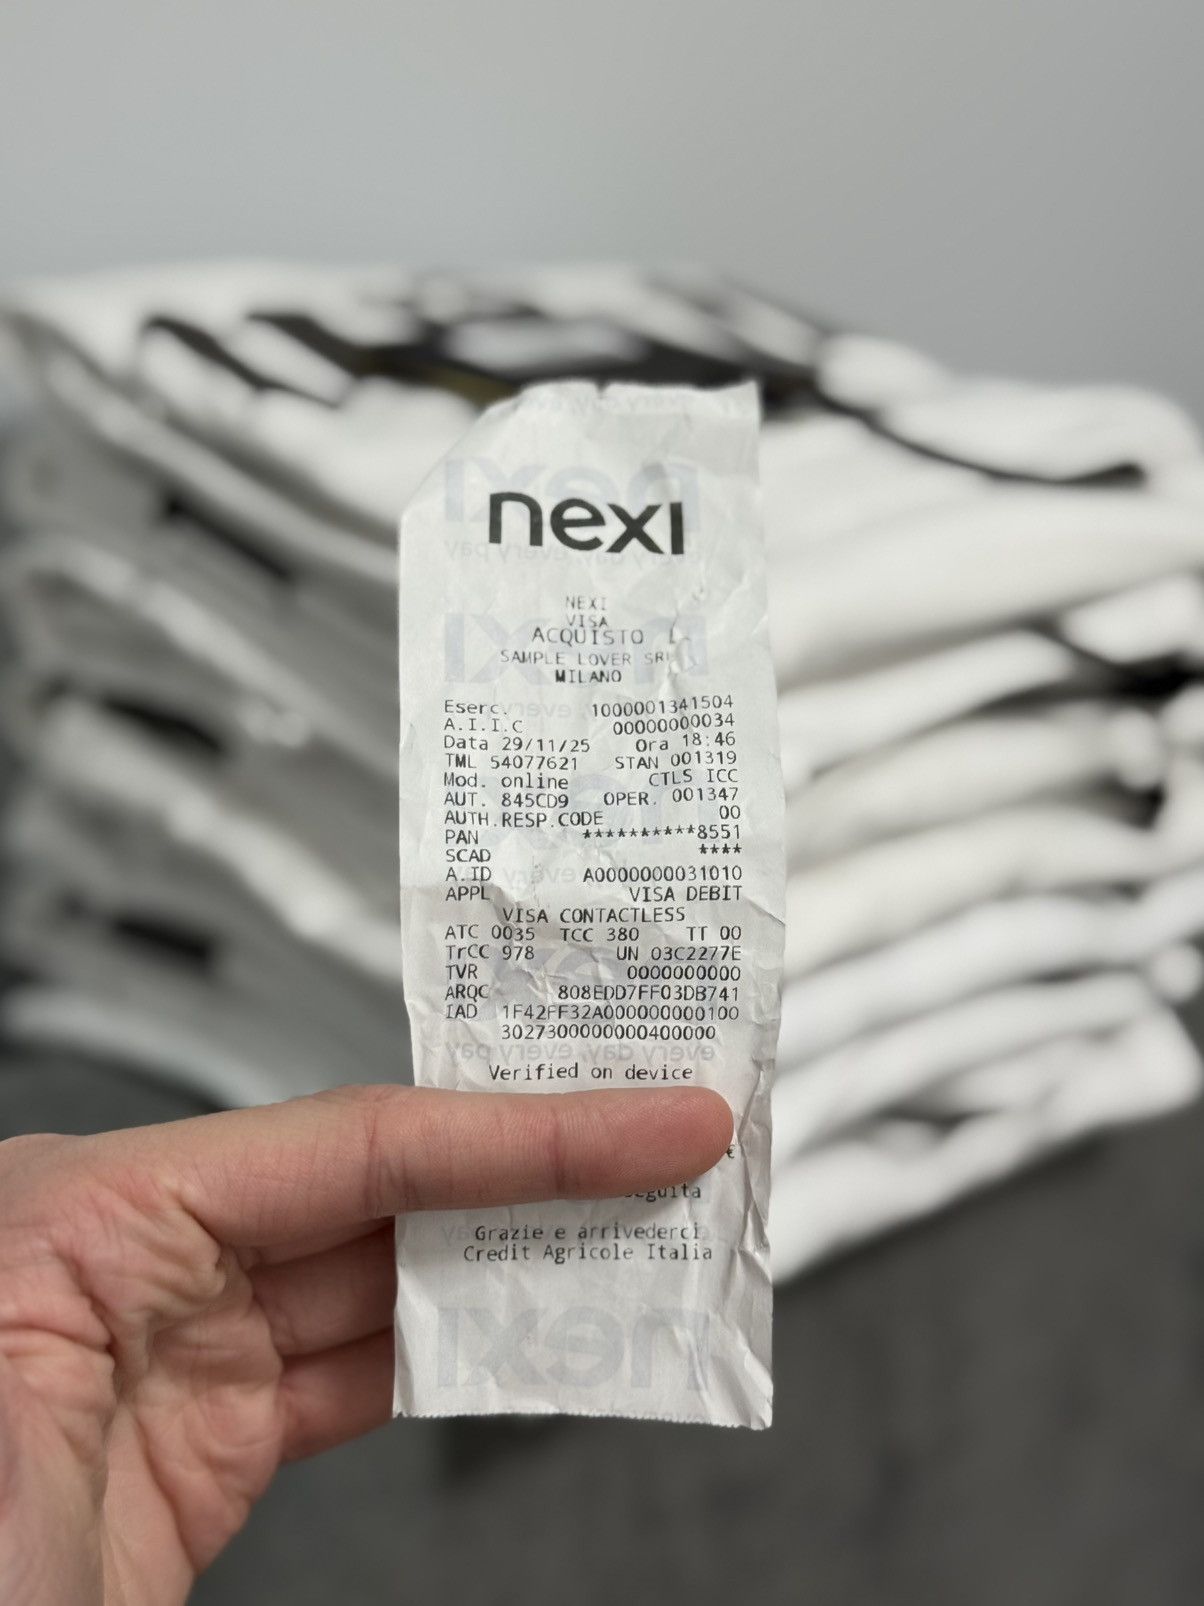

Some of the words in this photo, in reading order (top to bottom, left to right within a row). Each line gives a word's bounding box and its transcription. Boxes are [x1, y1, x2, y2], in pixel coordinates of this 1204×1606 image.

[488, 491, 685, 555] nexi
[565, 595, 608, 611] NEXI
[566, 614, 609, 628] VISA
[531, 626, 644, 647] ACQUISTO
[500, 649, 566, 665] SAMPLE
[578, 653, 632, 666] LOVER
[555, 668, 622, 684] MILANO
[443, 699, 509, 715] Eserc.
[592, 694, 734, 718] 1000001341504
[612, 712, 735, 736] 00000000034
[443, 735, 489, 751] Data
[501, 736, 591, 753] 29/11/25
[635, 738, 669, 753] Ora
[682, 731, 736, 747] 18:46
[445, 752, 477, 769] TML
[490, 754, 578, 771] 54077621
[614, 755, 659, 770] STAN
[670, 750, 737, 768] 001319
[443, 771, 486, 788] Mod.
[500, 772, 569, 790] online
[648, 768, 693, 787] CTLS
[706, 768, 739, 784] ICC
[443, 791, 486, 808] AUT.
[501, 792, 569, 809] 845CD9
[603, 791, 657, 806] OPER.
[671, 787, 739, 803] 001347
[719, 804, 741, 820] 00
[445, 829, 479, 845] PAN
[445, 848, 491, 863] SCAD
[445, 866, 492, 882] A.ID
[582, 865, 742, 883] A0000000031010
[445, 885, 491, 902] APPL
[629, 885, 676, 903] VISA
[686, 885, 743, 902] DEBIT
[502, 907, 549, 924] VISA
[559, 906, 686, 924] CONTACTLESS
[444, 923, 480, 940] ATC
[491, 924, 536, 942] 0035
[559, 927, 594, 943] TCC
[606, 926, 640, 942] 380
[686, 925, 708, 942] TT
[719, 925, 742, 941] 00
[445, 943, 490, 960] TrCC
[502, 945, 535, 961] 978
[616, 946, 639, 961] UN
[651, 945, 742, 962] 03C2277E
[445, 963, 478, 980] TVR
[626, 965, 742, 982] 0000000000
[444, 983, 490, 1003] ARQC
[557, 984, 739, 1001] 808EDD7FF03DB741
[445, 1003, 478, 1019] IAD
[502, 1003, 740, 1021] 1F42FF32A000000000100
[501, 1023, 717, 1041] 3027300000000400000
[488, 1062, 579, 1081] Verified
[591, 1066, 613, 1079] on
[624, 1063, 693, 1081] device
[475, 1224, 544, 1241] Grazie
[554, 1226, 567, 1241] e
[577, 1221, 700, 1241] arrivederci
[463, 1244, 531, 1262] Credit
[542, 1243, 634, 1264] Agricole
[647, 1243, 713, 1261] Italia
